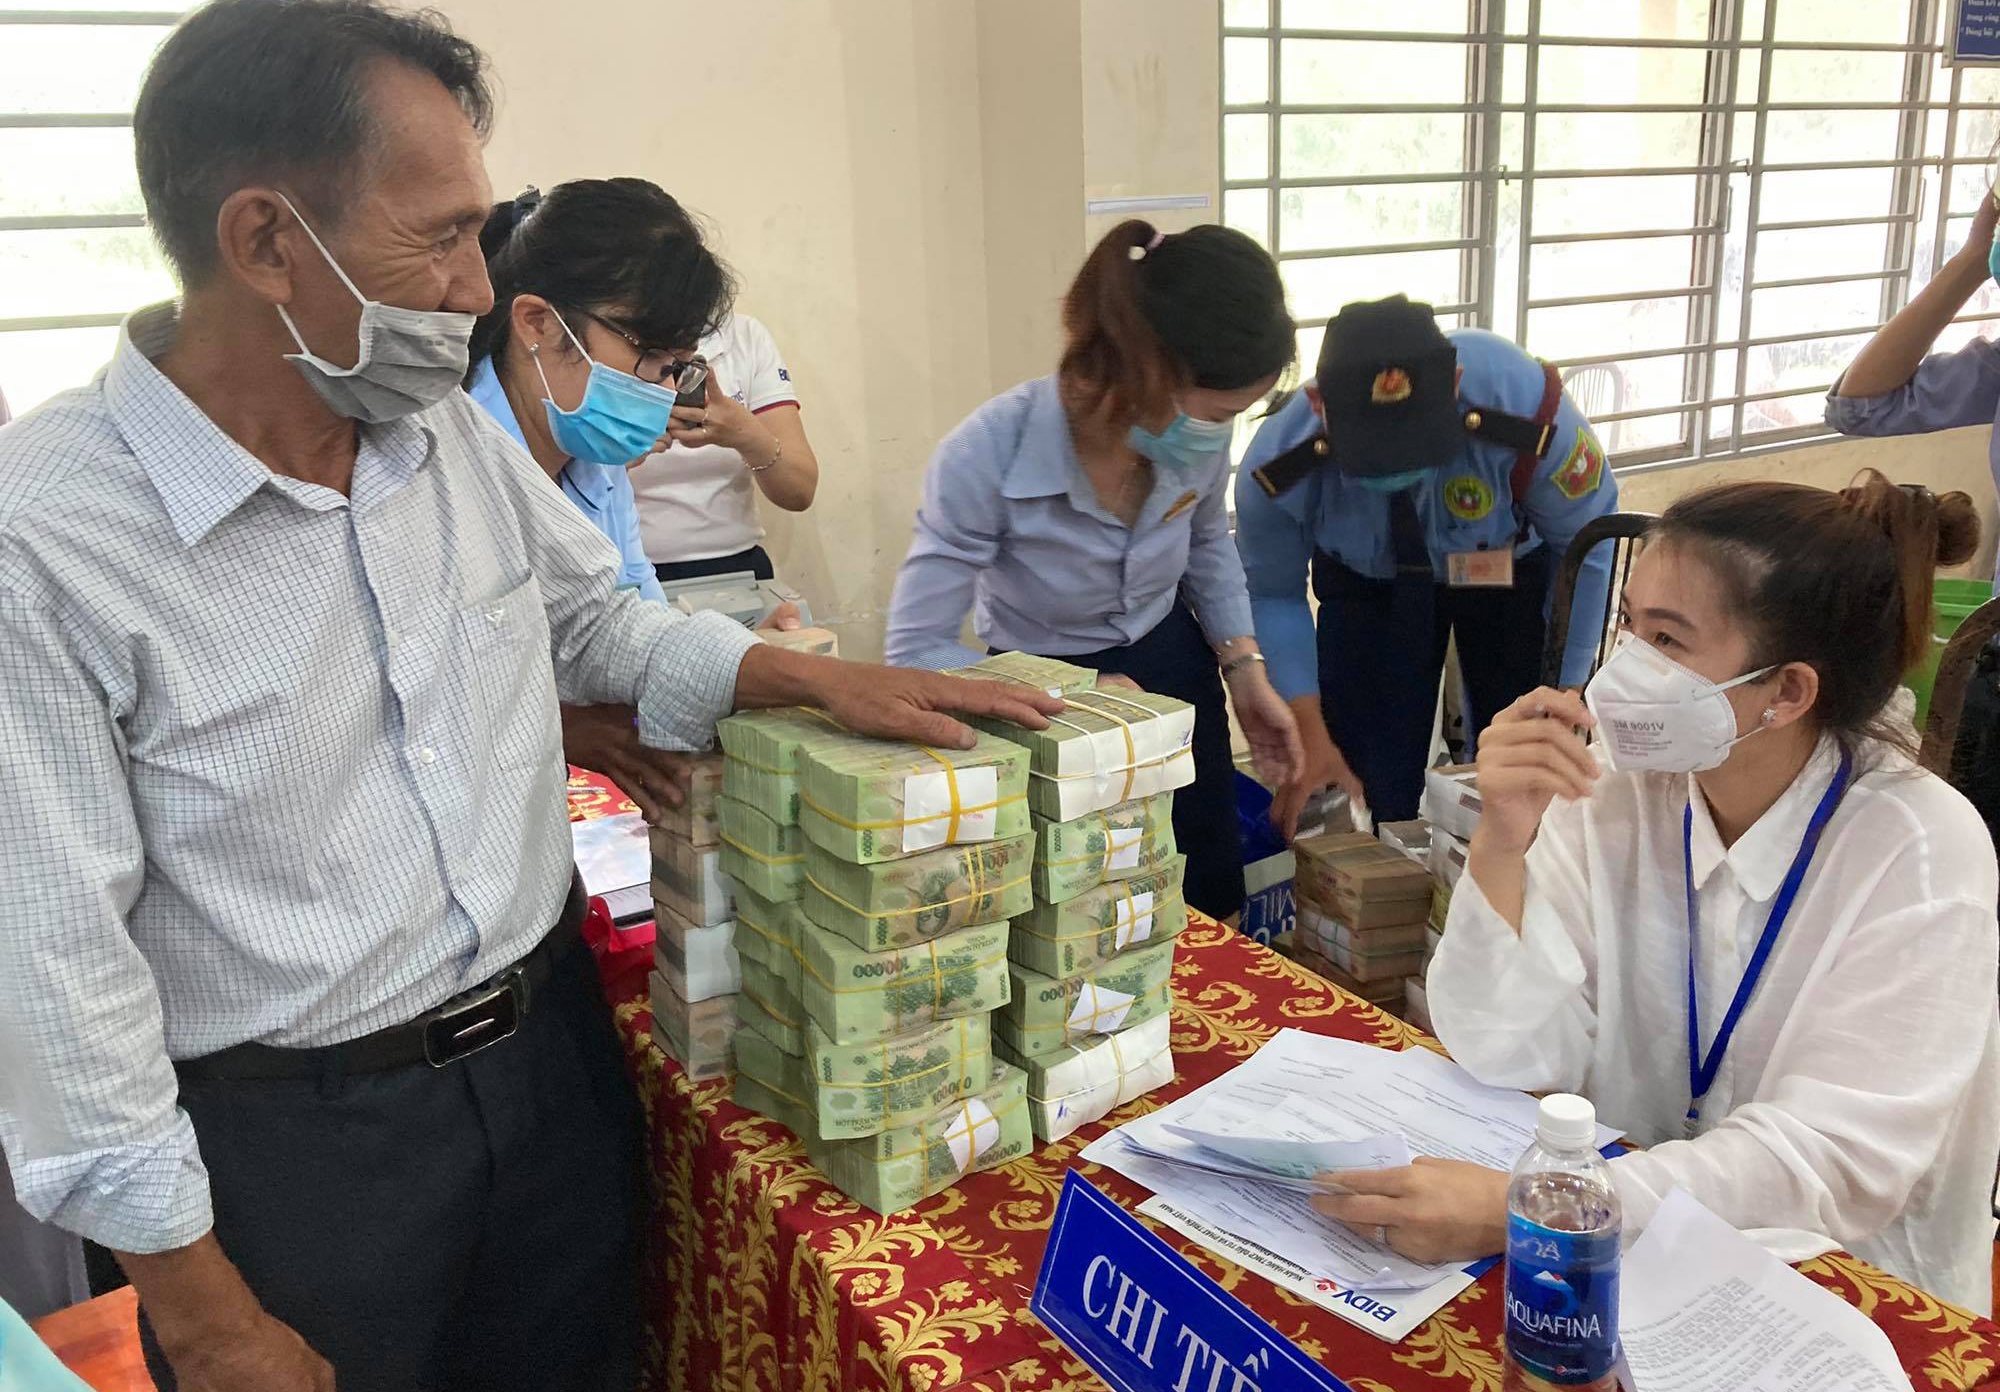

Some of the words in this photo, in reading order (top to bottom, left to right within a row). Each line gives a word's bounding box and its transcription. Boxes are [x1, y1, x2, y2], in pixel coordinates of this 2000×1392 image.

[1083, 1254, 1169, 1369] CHI
[1332, 1289, 1397, 1322] BIDV
[1506, 1291, 1602, 1338] AQUAFINA
